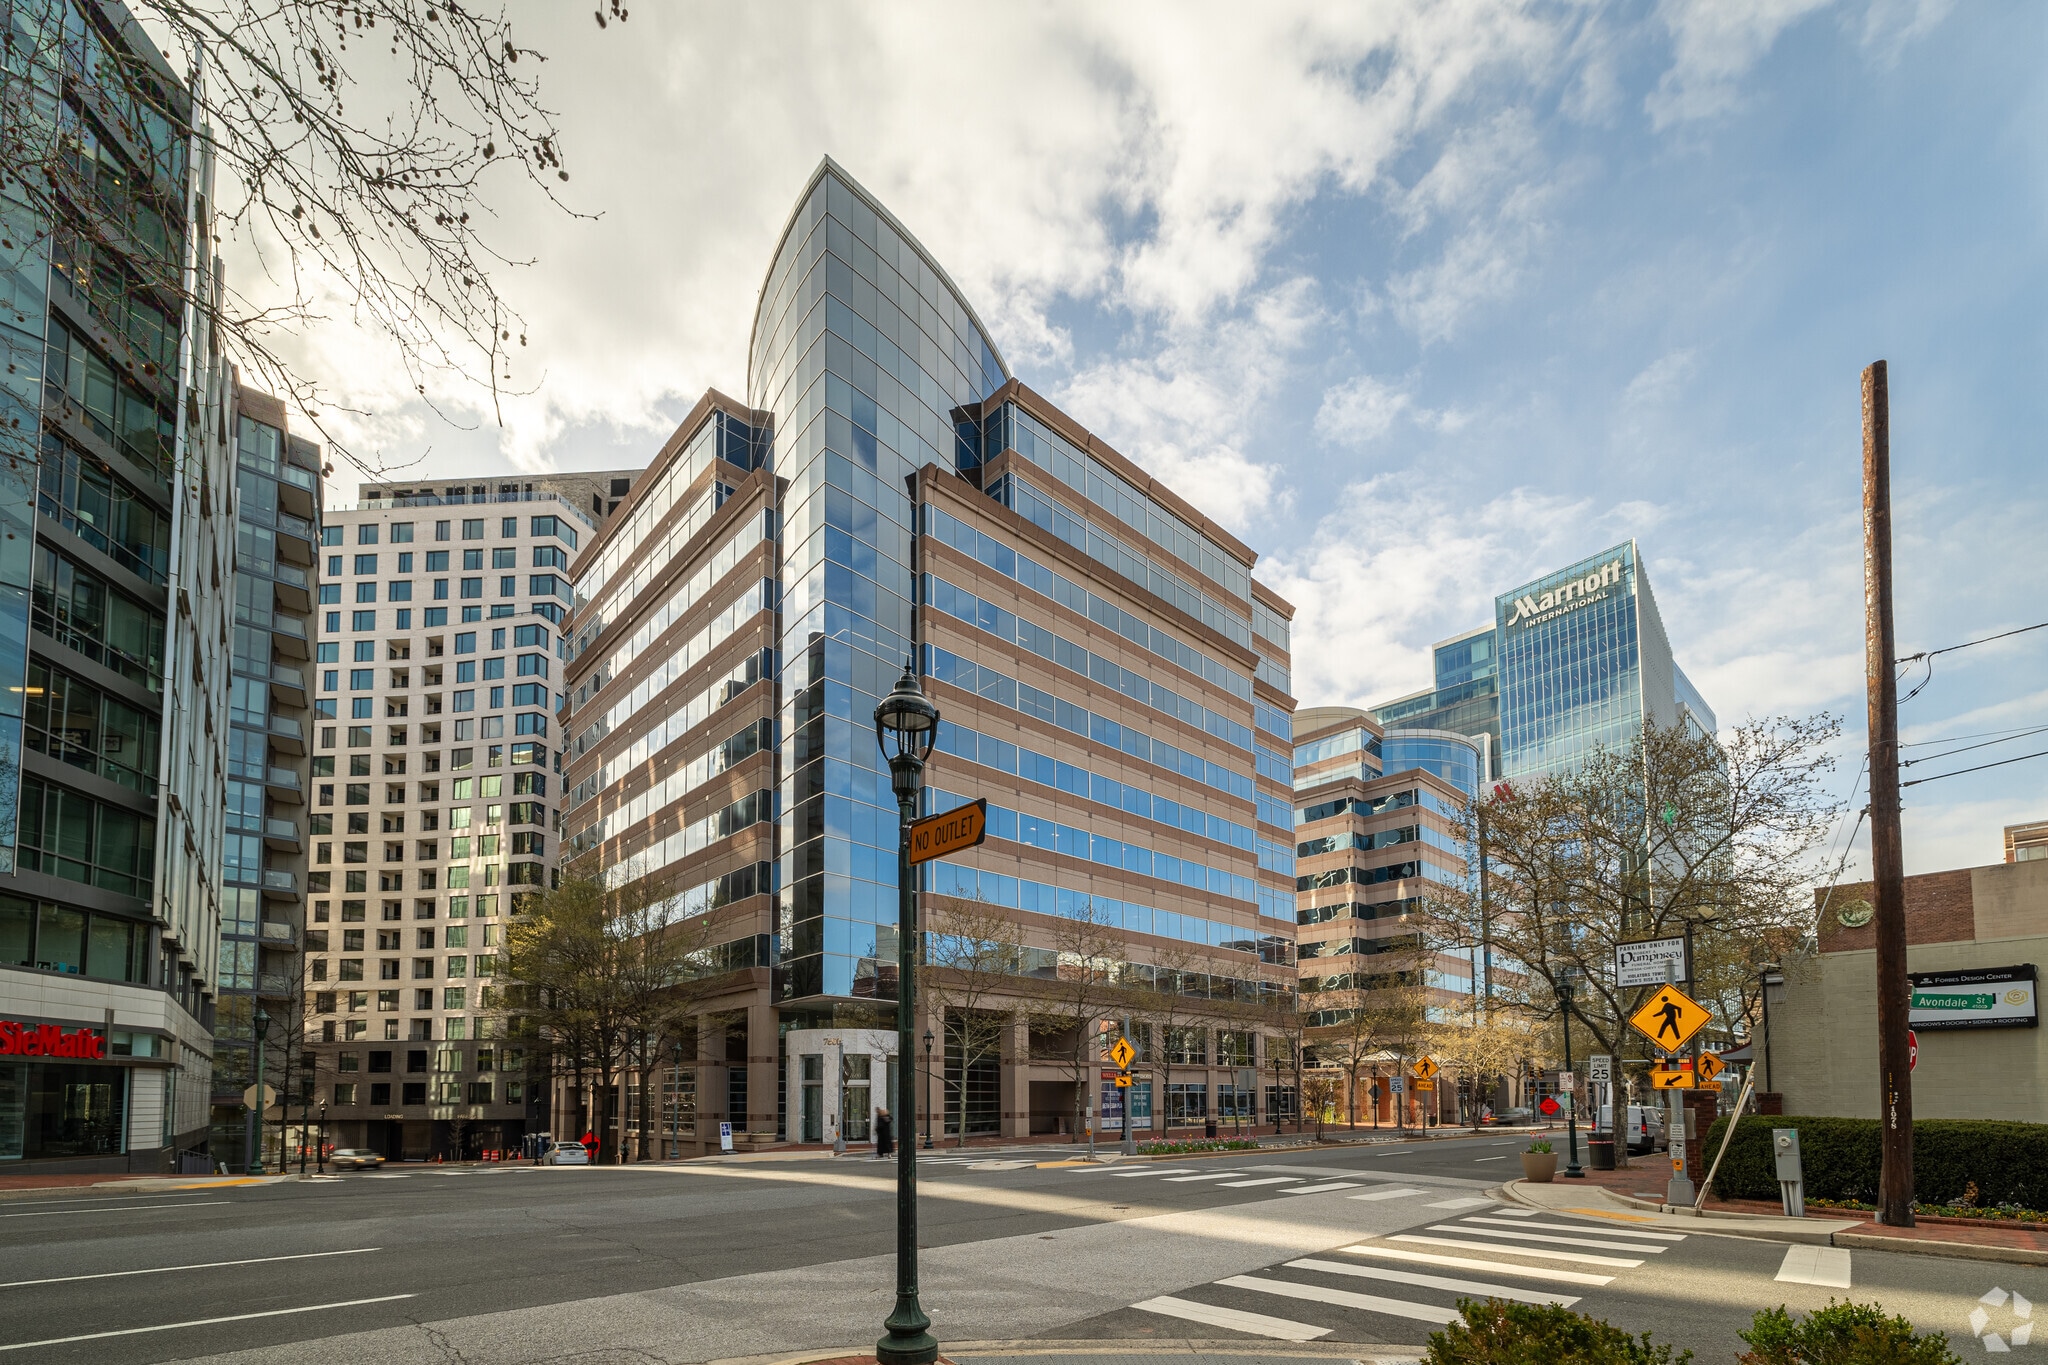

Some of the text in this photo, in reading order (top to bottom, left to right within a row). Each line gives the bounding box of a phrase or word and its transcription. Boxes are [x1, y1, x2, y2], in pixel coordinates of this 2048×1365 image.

[1507, 558, 1622, 627] Marriott
[1525, 591, 1609, 629] INTERNATIONAL
[915, 814, 974, 852] NO OUTLET
[1620, 944, 1646, 952] PARKING
[1918, 997, 1968, 1007] Avondale
[0, 1020, 106, 1059] SieMatic
[1591, 1069, 1609, 1080] 25
